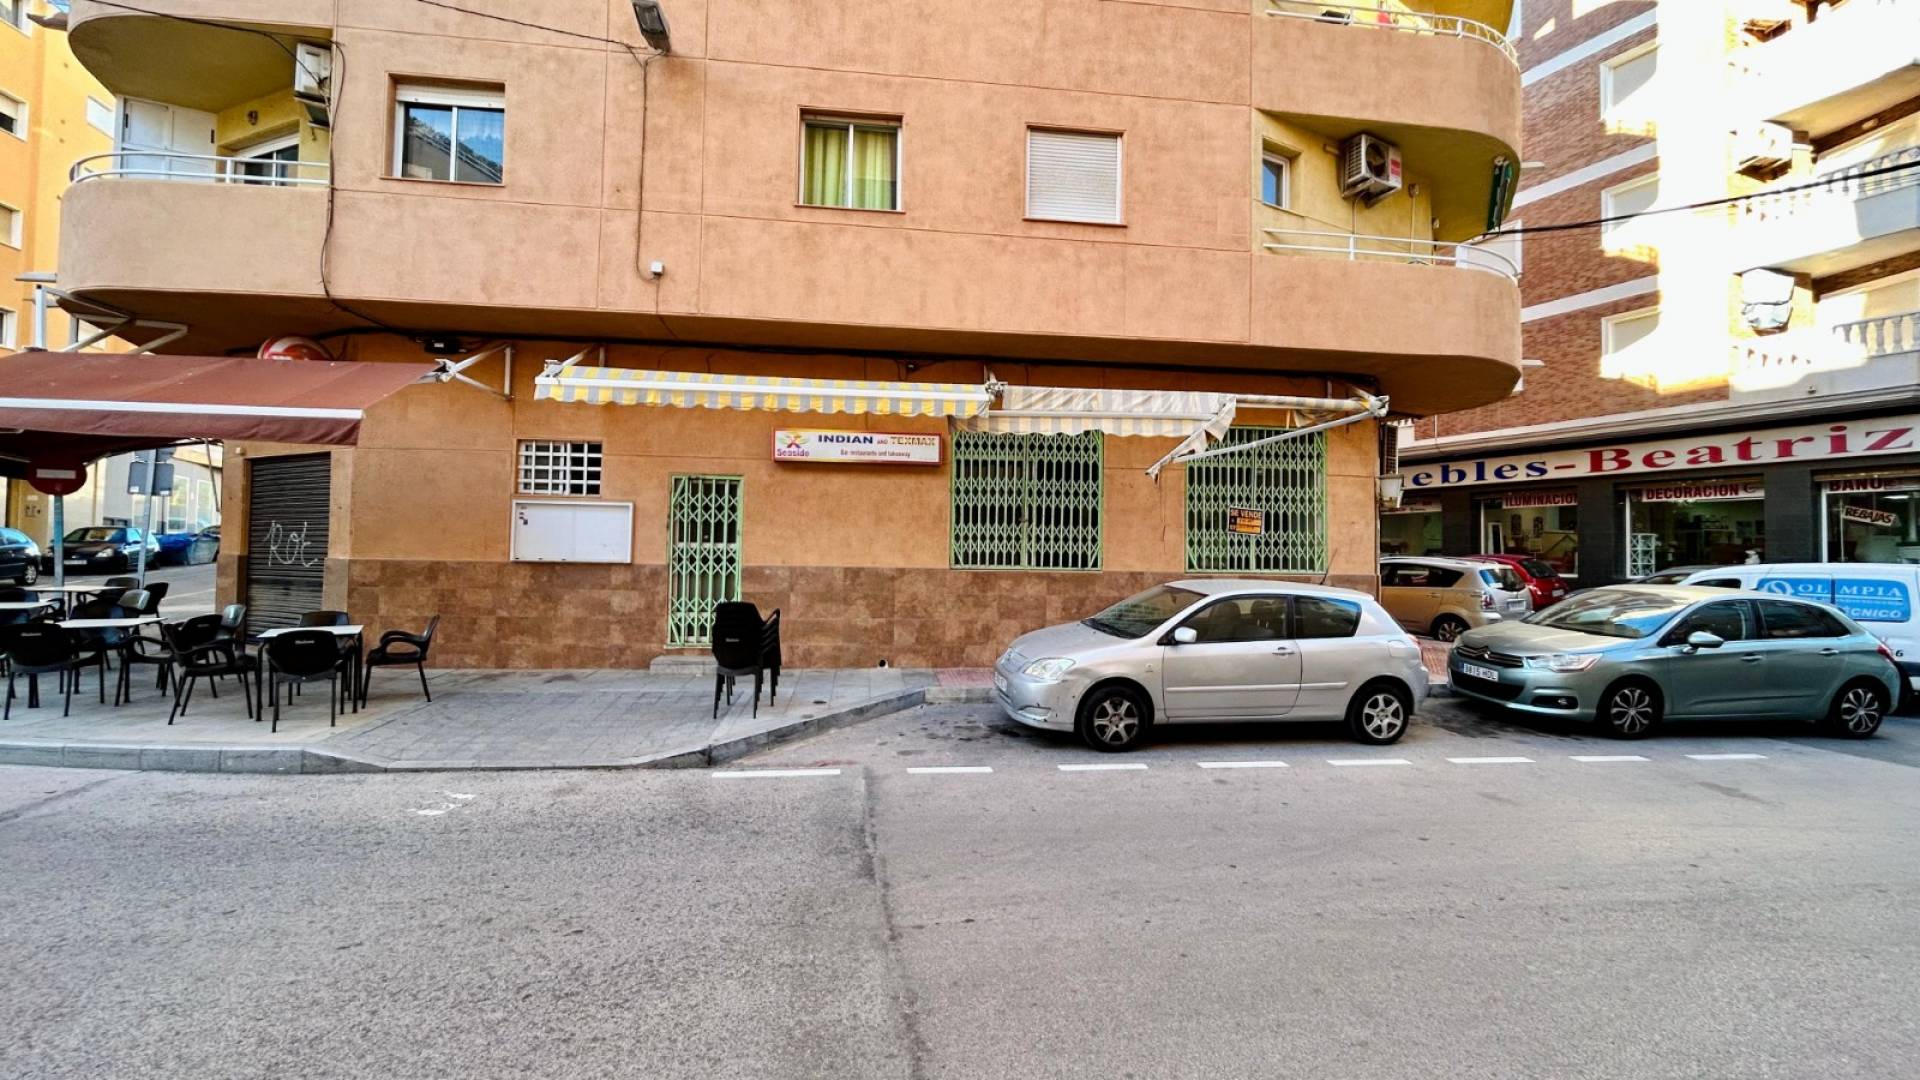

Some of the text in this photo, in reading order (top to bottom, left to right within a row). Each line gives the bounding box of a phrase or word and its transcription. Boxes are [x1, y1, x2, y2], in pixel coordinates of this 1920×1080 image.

[818, 435, 873, 444] INDIAN
[890, 436, 936, 446] TEXMAX
[777, 448, 810, 458] Seaside
